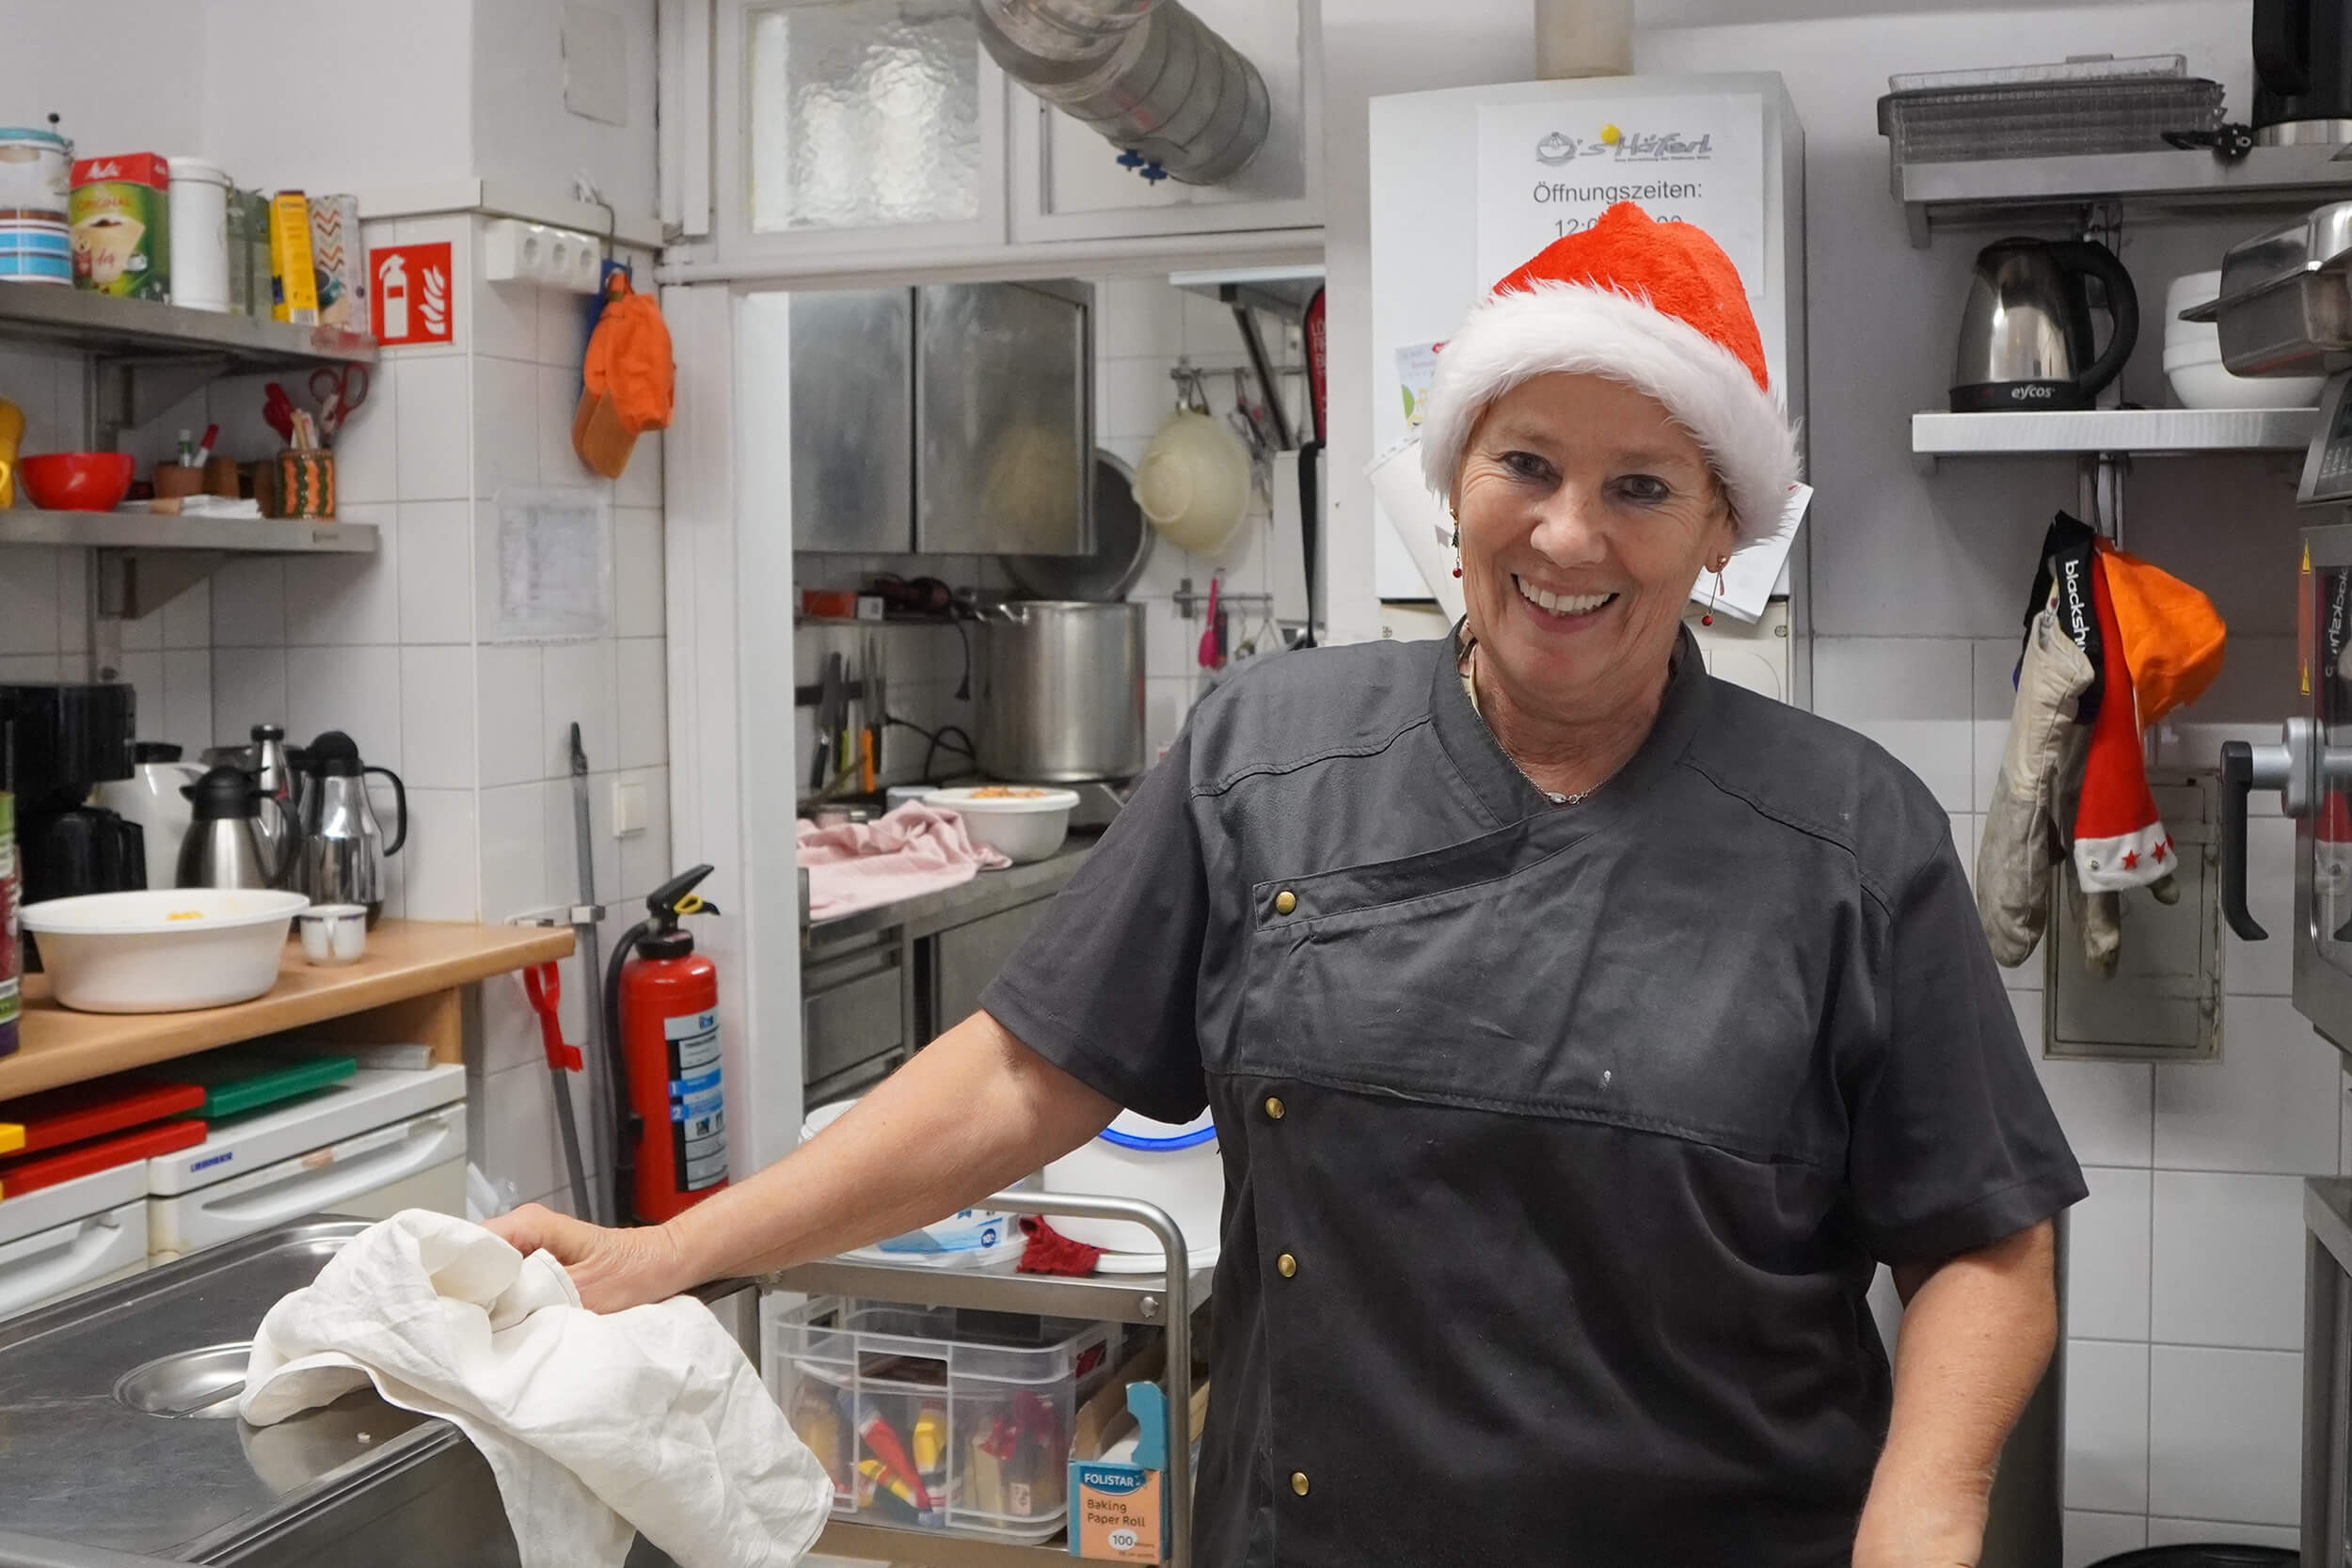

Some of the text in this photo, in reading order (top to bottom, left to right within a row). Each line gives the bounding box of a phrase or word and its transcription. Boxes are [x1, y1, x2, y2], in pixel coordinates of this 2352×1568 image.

[1534, 181, 1702, 205] Öffnungszeiten:
[1084, 1473, 1134, 1487] FOLISTAR
[1088, 1499, 1127, 1514] Baking
[1088, 1513, 1146, 1528] Paper Roll
[1112, 1534, 1134, 1546] 100
